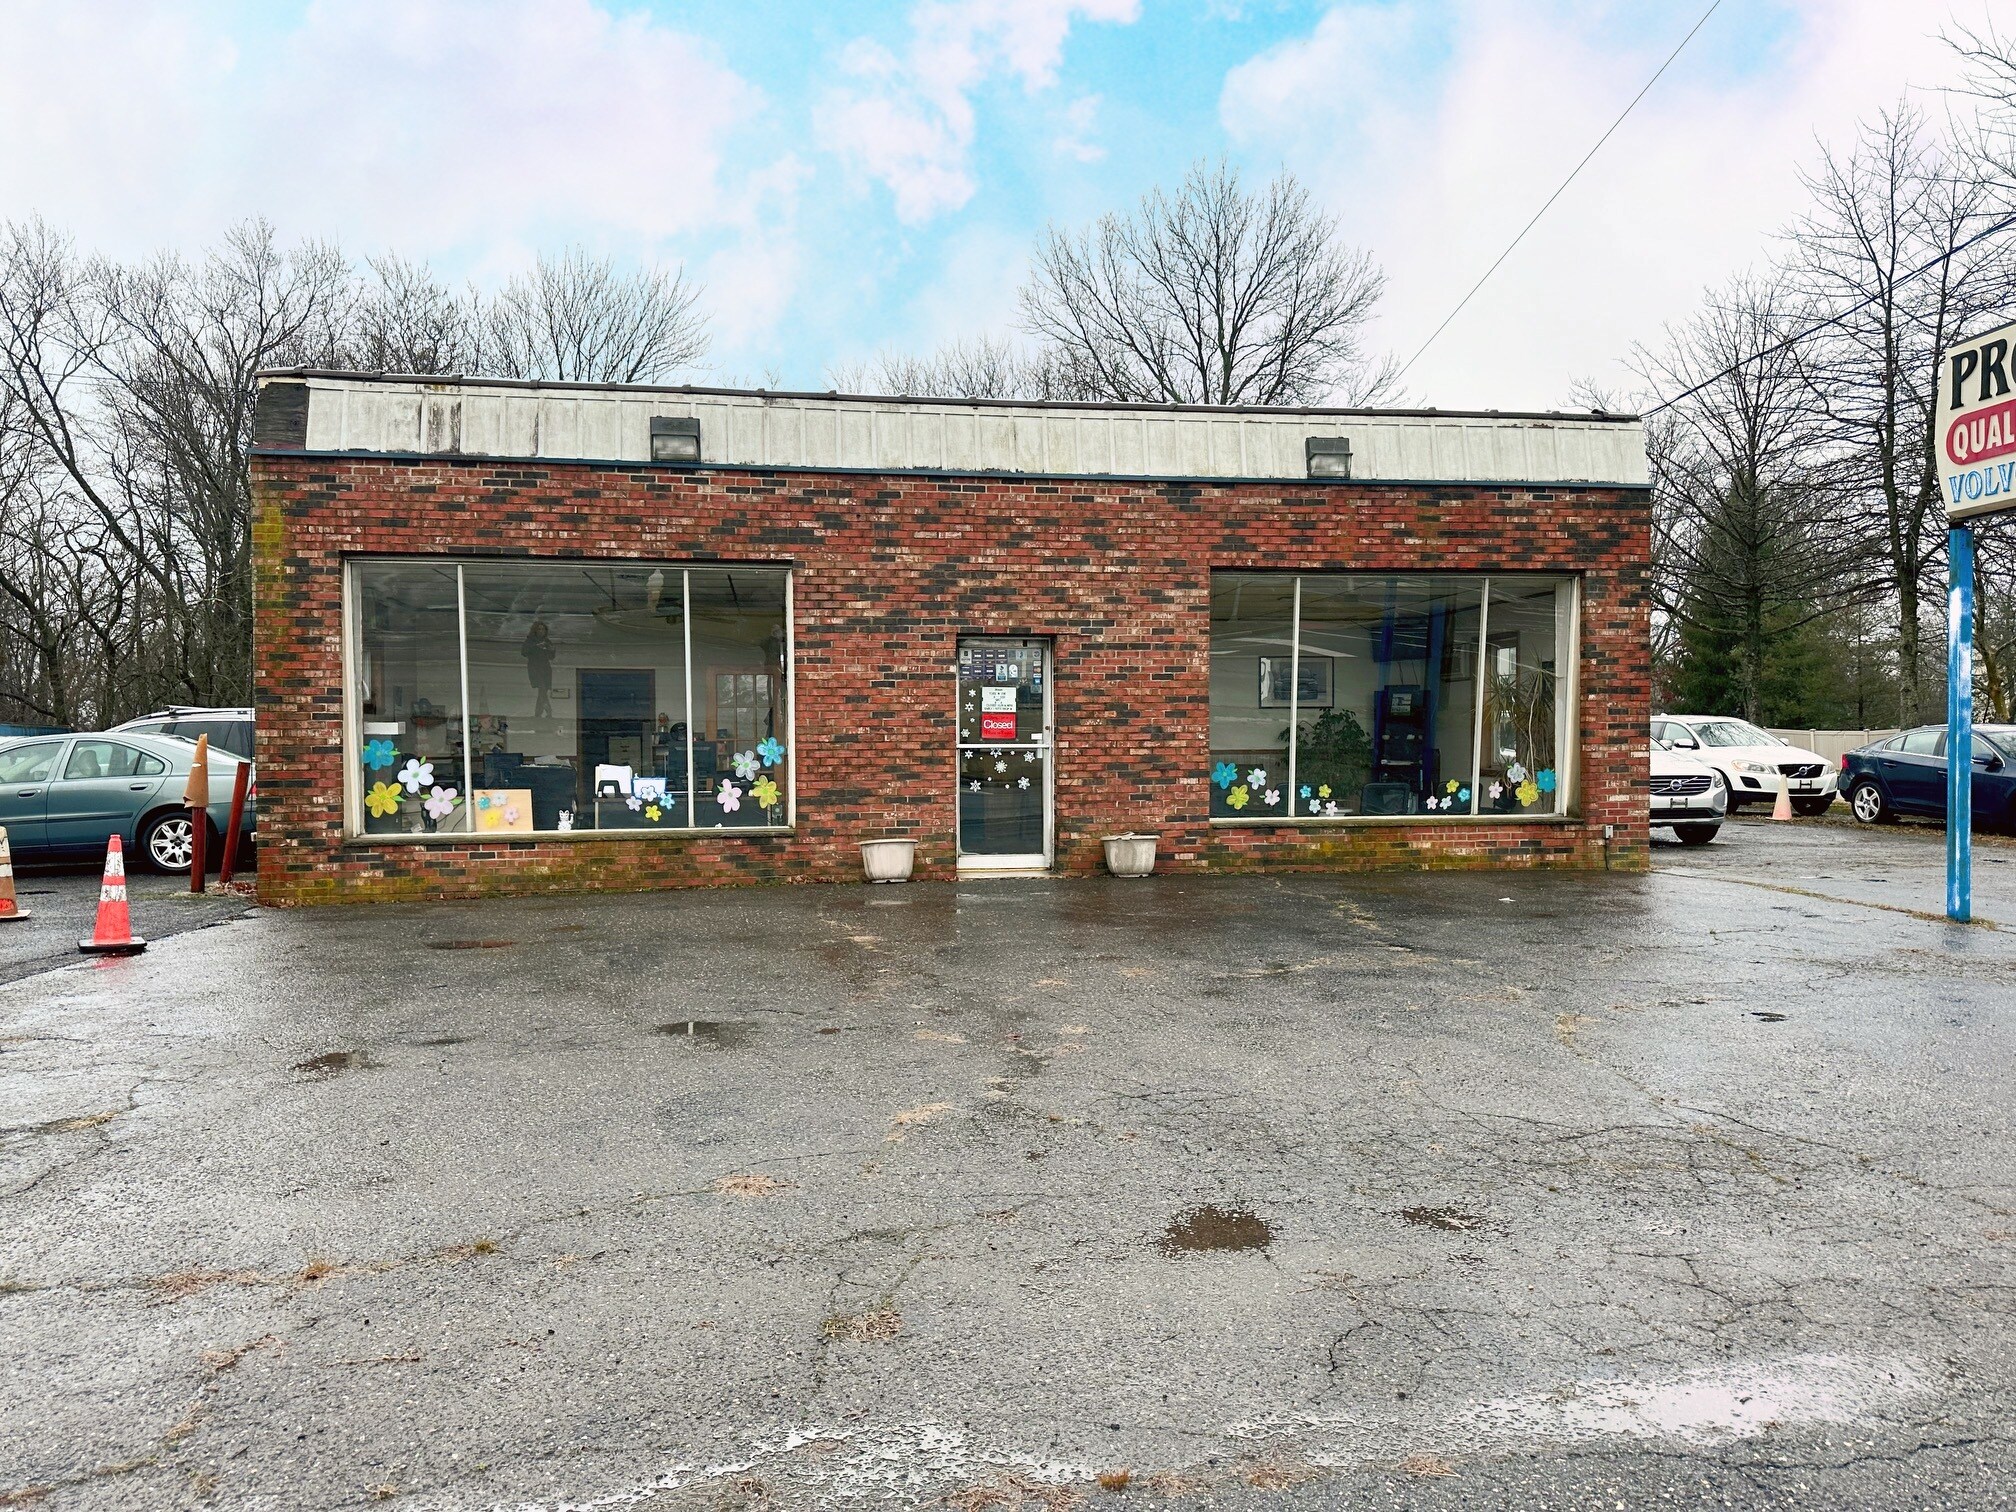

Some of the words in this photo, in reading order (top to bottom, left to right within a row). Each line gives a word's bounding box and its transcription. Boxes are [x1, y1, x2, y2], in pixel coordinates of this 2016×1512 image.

[1950, 338, 2016, 410] PR
[1953, 411, 2015, 461] QUAL
[1949, 461, 2016, 503] VOLV
[983, 719, 1013, 729] Closed
